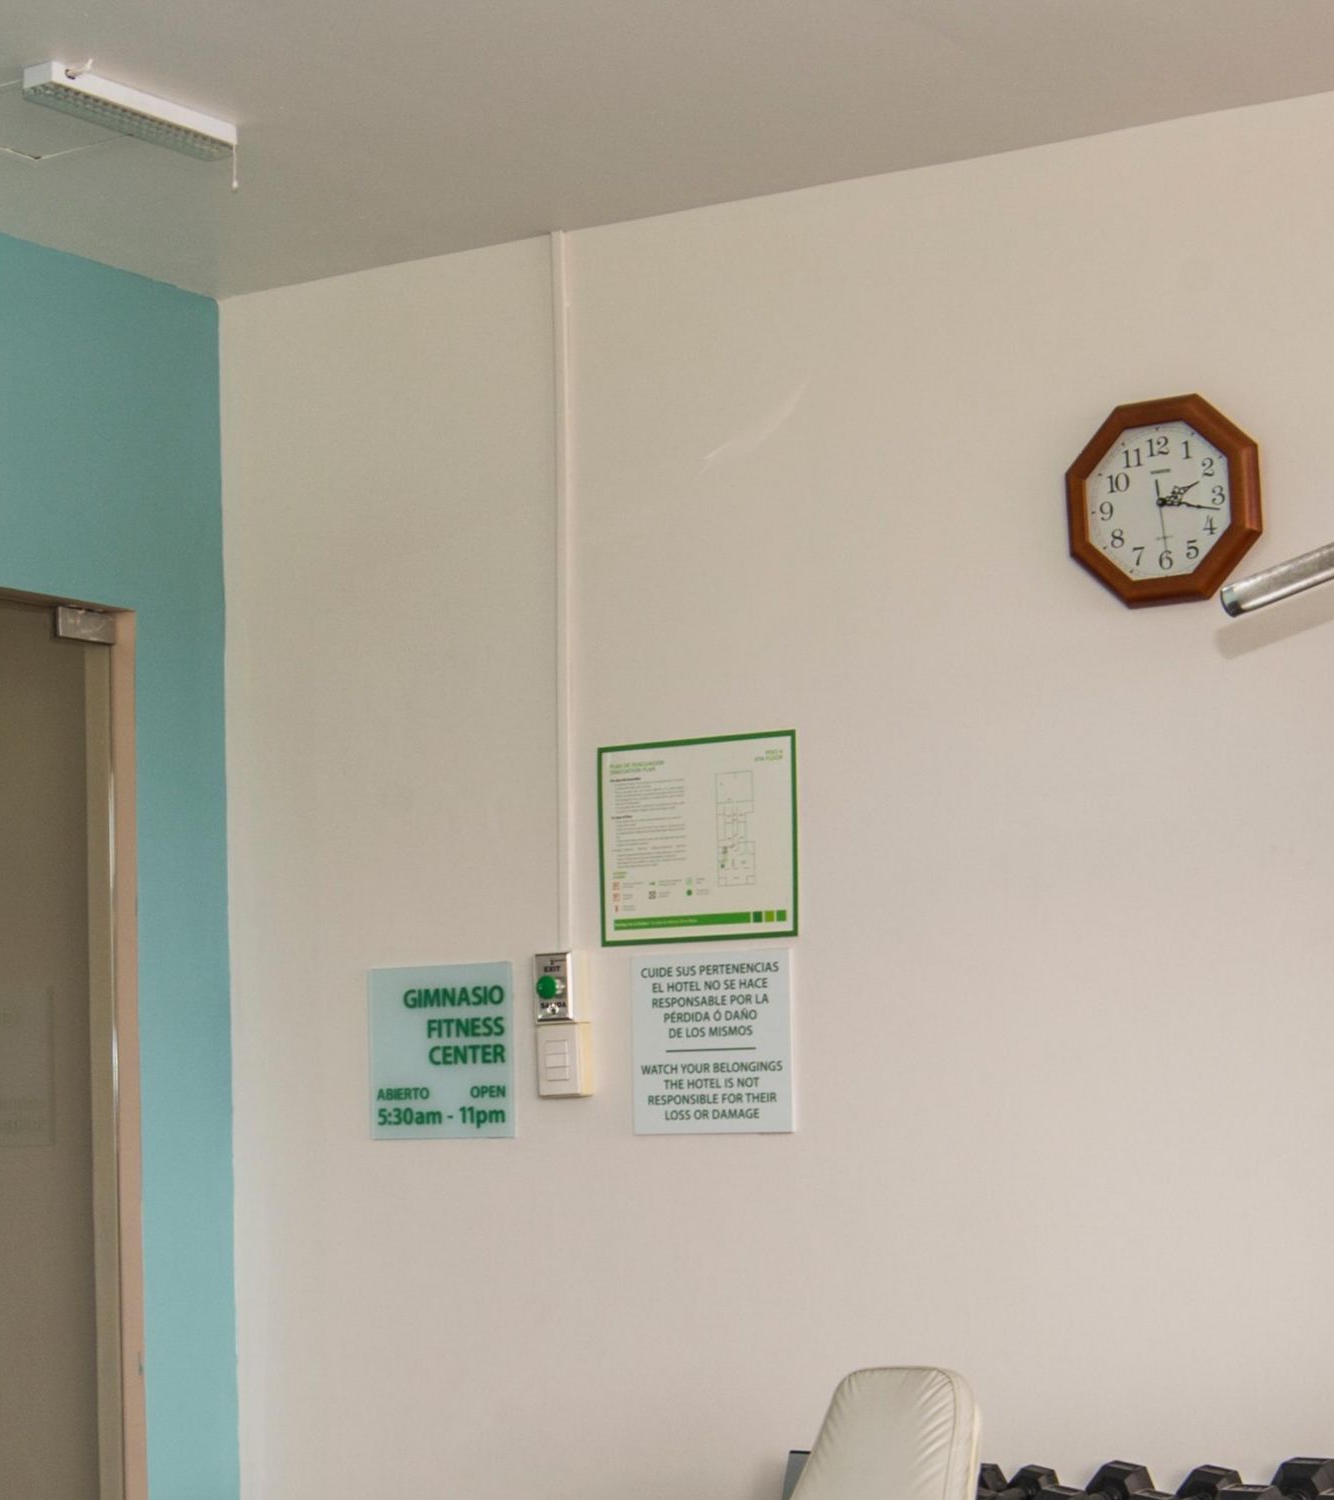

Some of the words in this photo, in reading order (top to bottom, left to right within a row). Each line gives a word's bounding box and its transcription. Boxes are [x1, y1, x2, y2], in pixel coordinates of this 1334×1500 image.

[1146, 436, 1170, 457] 12
[1182, 440, 1192, 460] 1
[1123, 448, 1144, 468] 11
[1201, 457, 1215, 477] 2
[1107, 472, 1130, 494] 10
[1211, 485, 1226, 506] 3
[1099, 501, 1114, 521] 9
[1203, 514, 1217, 535] 4
[1110, 528, 1125, 549] 8
[1132, 546, 1145, 566] 7
[1186, 539, 1199, 559] 5
[1158, 550, 1173, 570] 6
[640, 967, 673, 979] CUIDE
[676, 965, 697, 977] SUS
[699, 961, 779, 976] PERTENENCIAS
[652, 982, 664, 994] EL
[667, 981, 701, 993] HOTEL
[704, 980, 721, 991] NO
[724, 979, 736, 990] SE
[739, 977, 768, 989] HACE
[403, 985, 504, 1009] GIMNASIO
[652, 995, 727, 1009] RESPONSABLE
[730, 994, 752, 1005] POR
[755, 993, 769, 1005] LA
[663, 1010, 710, 1024] PÉRDIDA
[725, 1007, 757, 1021] DAÑO
[426, 1016, 505, 1039] FITNESS
[668, 1027, 683, 1039] DE
[685, 1026, 706, 1038] LOS
[708, 1025, 753, 1038] MISMOS
[428, 1044, 506, 1065] CENTER
[641, 1064, 678, 1075] WATCH
[681, 1062, 710, 1074] YOUR
[713, 1060, 783, 1073] BELONGINGS
[377, 1087, 430, 1101] ABIERTO
[470, 1085, 506, 1098] OPEN
[664, 1079, 684, 1090] THE
[687, 1078, 722, 1089] HOTEL
[725, 1078, 734, 1088] IS
[737, 1077, 760, 1088] NOT
[648, 1094, 718, 1106] RESPONSIBLE
[721, 1093, 743, 1104] FOR
[745, 1092, 777, 1103] THEIR
[378, 1108, 442, 1126] 5:30am
[459, 1106, 506, 1129] 11pm
[665, 1110, 691, 1121] LOSS
[693, 1110, 709, 1120] OR
[712, 1108, 760, 1120] DAMAGE
